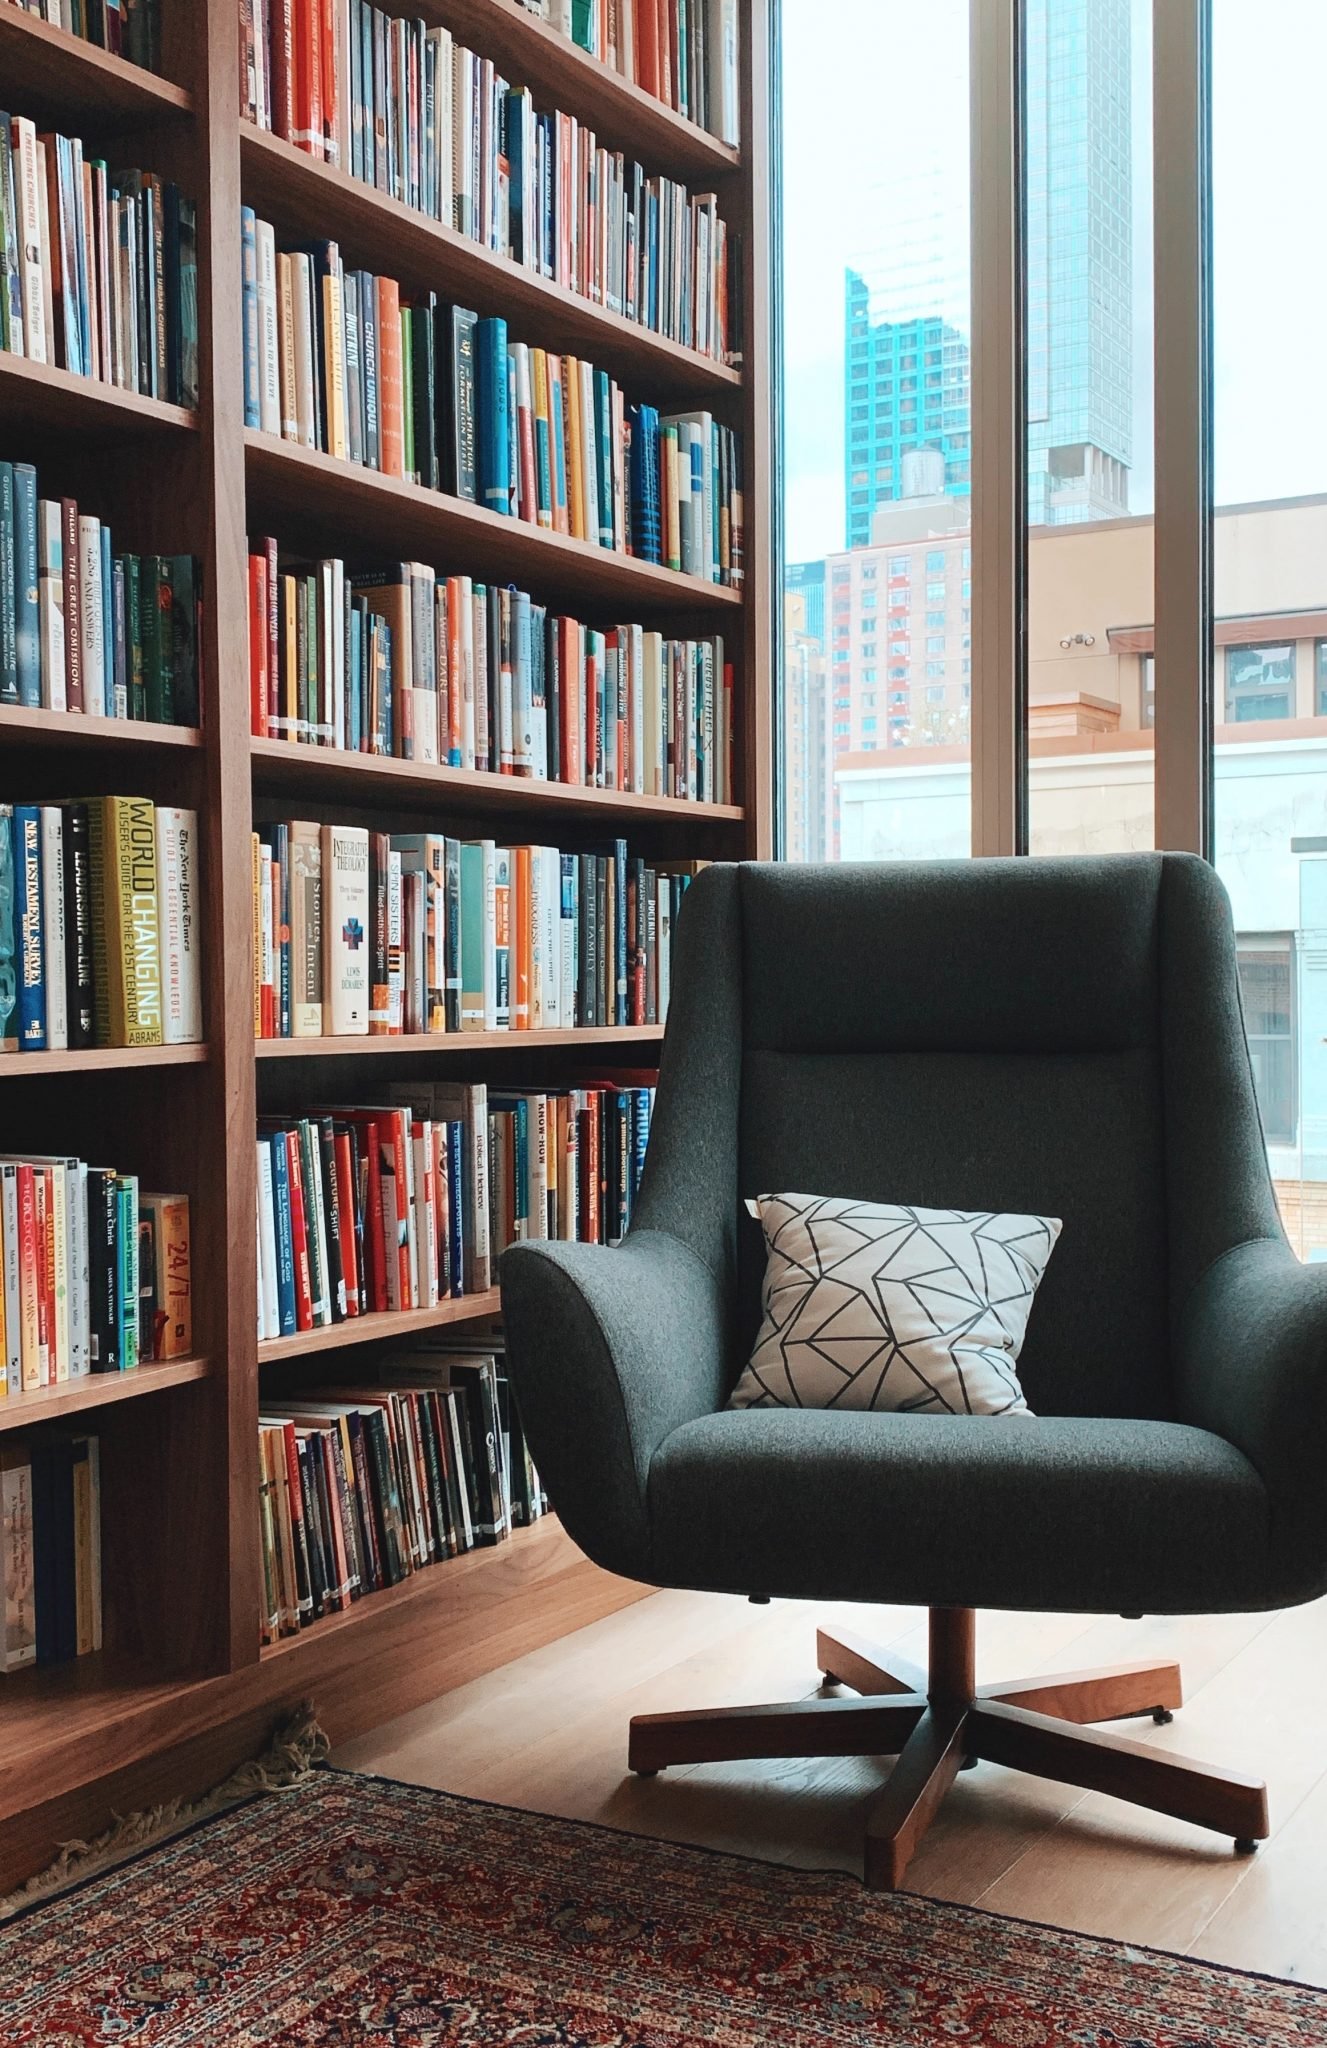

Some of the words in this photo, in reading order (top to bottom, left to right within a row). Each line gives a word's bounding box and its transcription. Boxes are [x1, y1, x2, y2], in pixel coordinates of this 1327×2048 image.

[25, 132, 35, 179] EMERGING
[27, 180, 36, 229] CHURCHES
[266, 306, 274, 346] REASONS
[345, 313, 358, 368] DOCTRINE
[364, 321, 374, 376] CHURCH
[268, 362, 276, 398] BELIEVE
[366, 379, 377, 433] UNIQUE
[86, 604, 95, 649] ANSWERS
[440, 655, 448, 696] DARE
[26, 821, 37, 851] NEW
[120, 812, 130, 851] USER'S
[166, 829, 175, 862] GUIDE
[179, 829, 188, 852] The
[121, 855, 131, 889] GUIDE
[168, 870, 175, 882] TO
[180, 854, 189, 880] New
[337, 856, 366, 872] THEOLOGY
[391, 864, 399, 890] SPIN
[28, 855, 39, 932] TESTAMENT
[75, 851, 89, 935] LEADERSHIP
[123, 893, 133, 916] FOR
[179, 883, 191, 912] York
[124, 919, 134, 939] THE
[168, 888, 178, 947] ESSENTIAL
[182, 915, 191, 951] Times
[391, 895, 400, 943] SISTERS
[30, 936, 41, 987] SURVEY
[78, 956, 90, 986] LINE
[125, 944, 135, 971] 21ST
[307, 944, 316, 996] Intent
[127, 975, 138, 1024] CENTURY
[170, 954, 180, 1020] KNOWLEDGE
[129, 1031, 161, 1044] ABRAMS
[107, 1209, 114, 1217] in
[47, 1214, 55, 1291] GUARDRAILS
[167, 1241, 189, 1296] 24/7
[285, 1248, 290, 1258] OF
